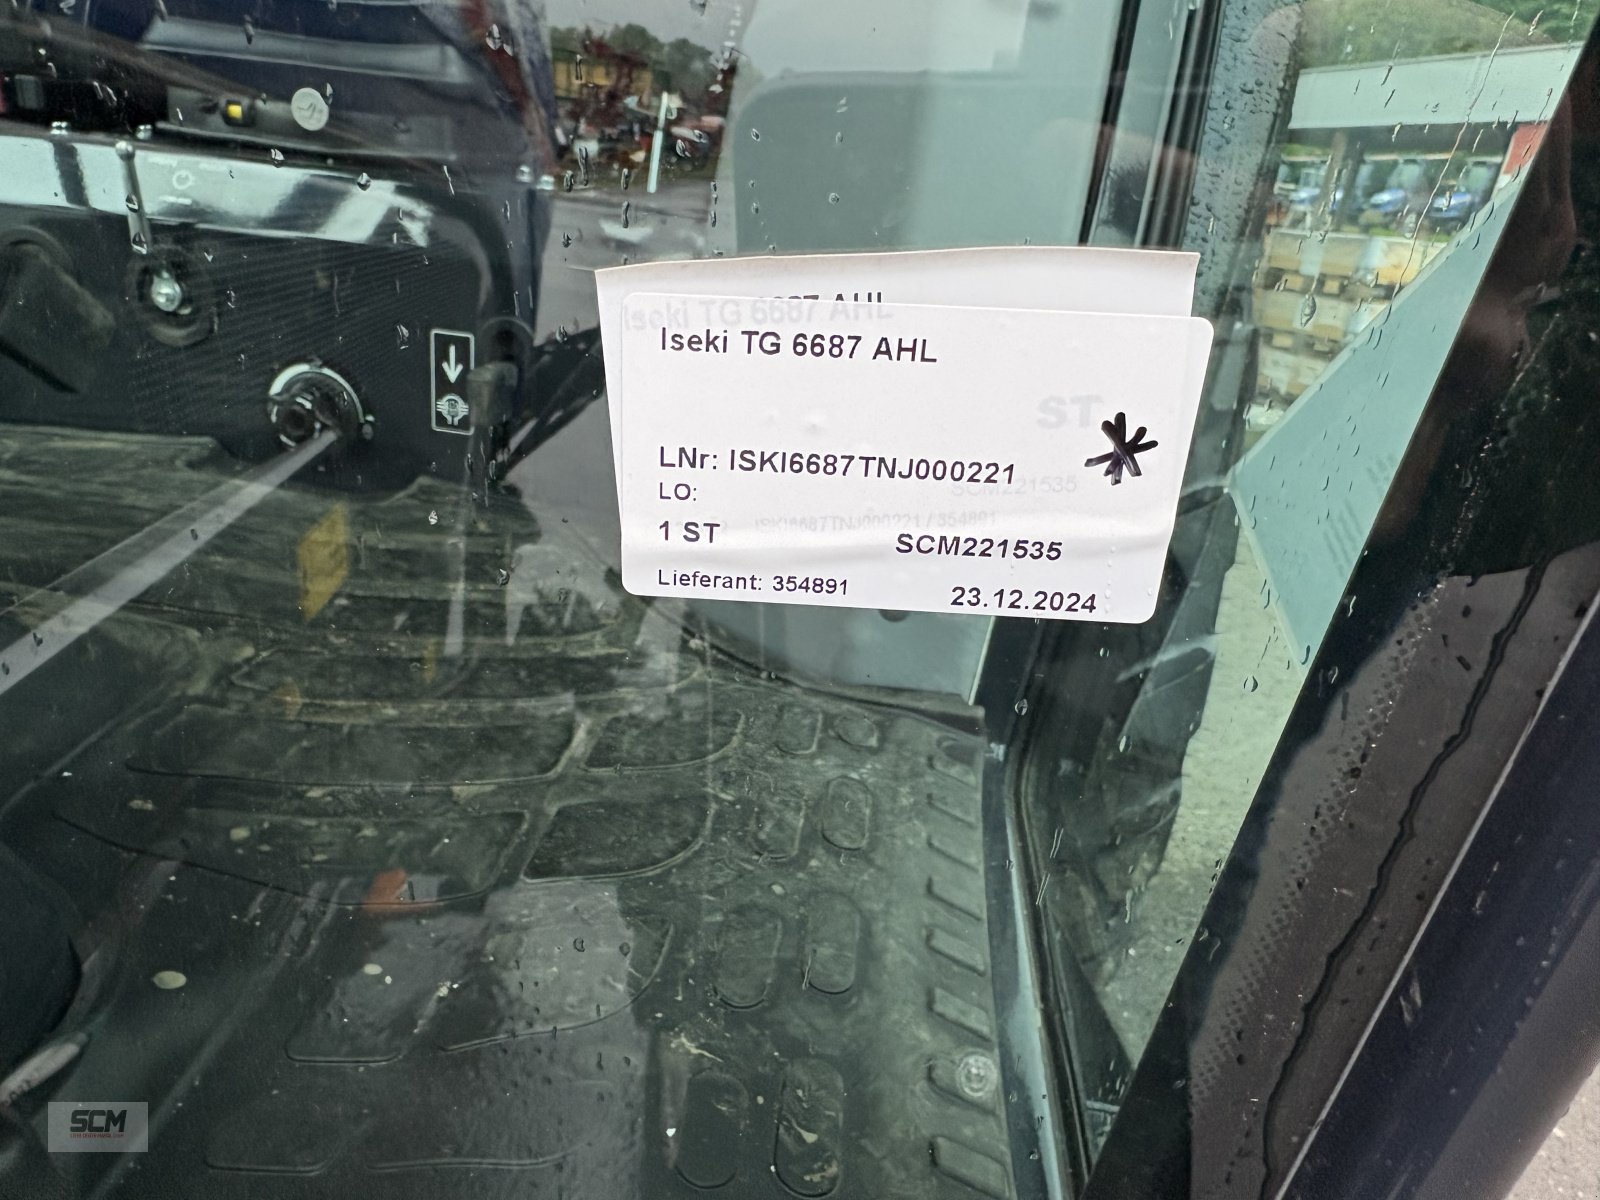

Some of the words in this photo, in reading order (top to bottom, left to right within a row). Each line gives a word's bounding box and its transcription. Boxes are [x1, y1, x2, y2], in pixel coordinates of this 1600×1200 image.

[661, 326, 728, 354] Iseki
[741, 330, 781, 355] TG
[792, 333, 862, 359] 6687
[872, 336, 937, 363] AHL
[659, 446, 718, 470] LNr:
[729, 449, 1015, 485] ISKI6687TNJ000221
[659, 482, 697, 502] LO:
[659, 520, 669, 541] 1
[683, 521, 721, 544] ST
[895, 533, 1063, 561] SCM221535
[658, 569, 763, 591] Lieferant:
[772, 575, 848, 596] 354891
[950, 586, 1097, 613] 23.12.2024
